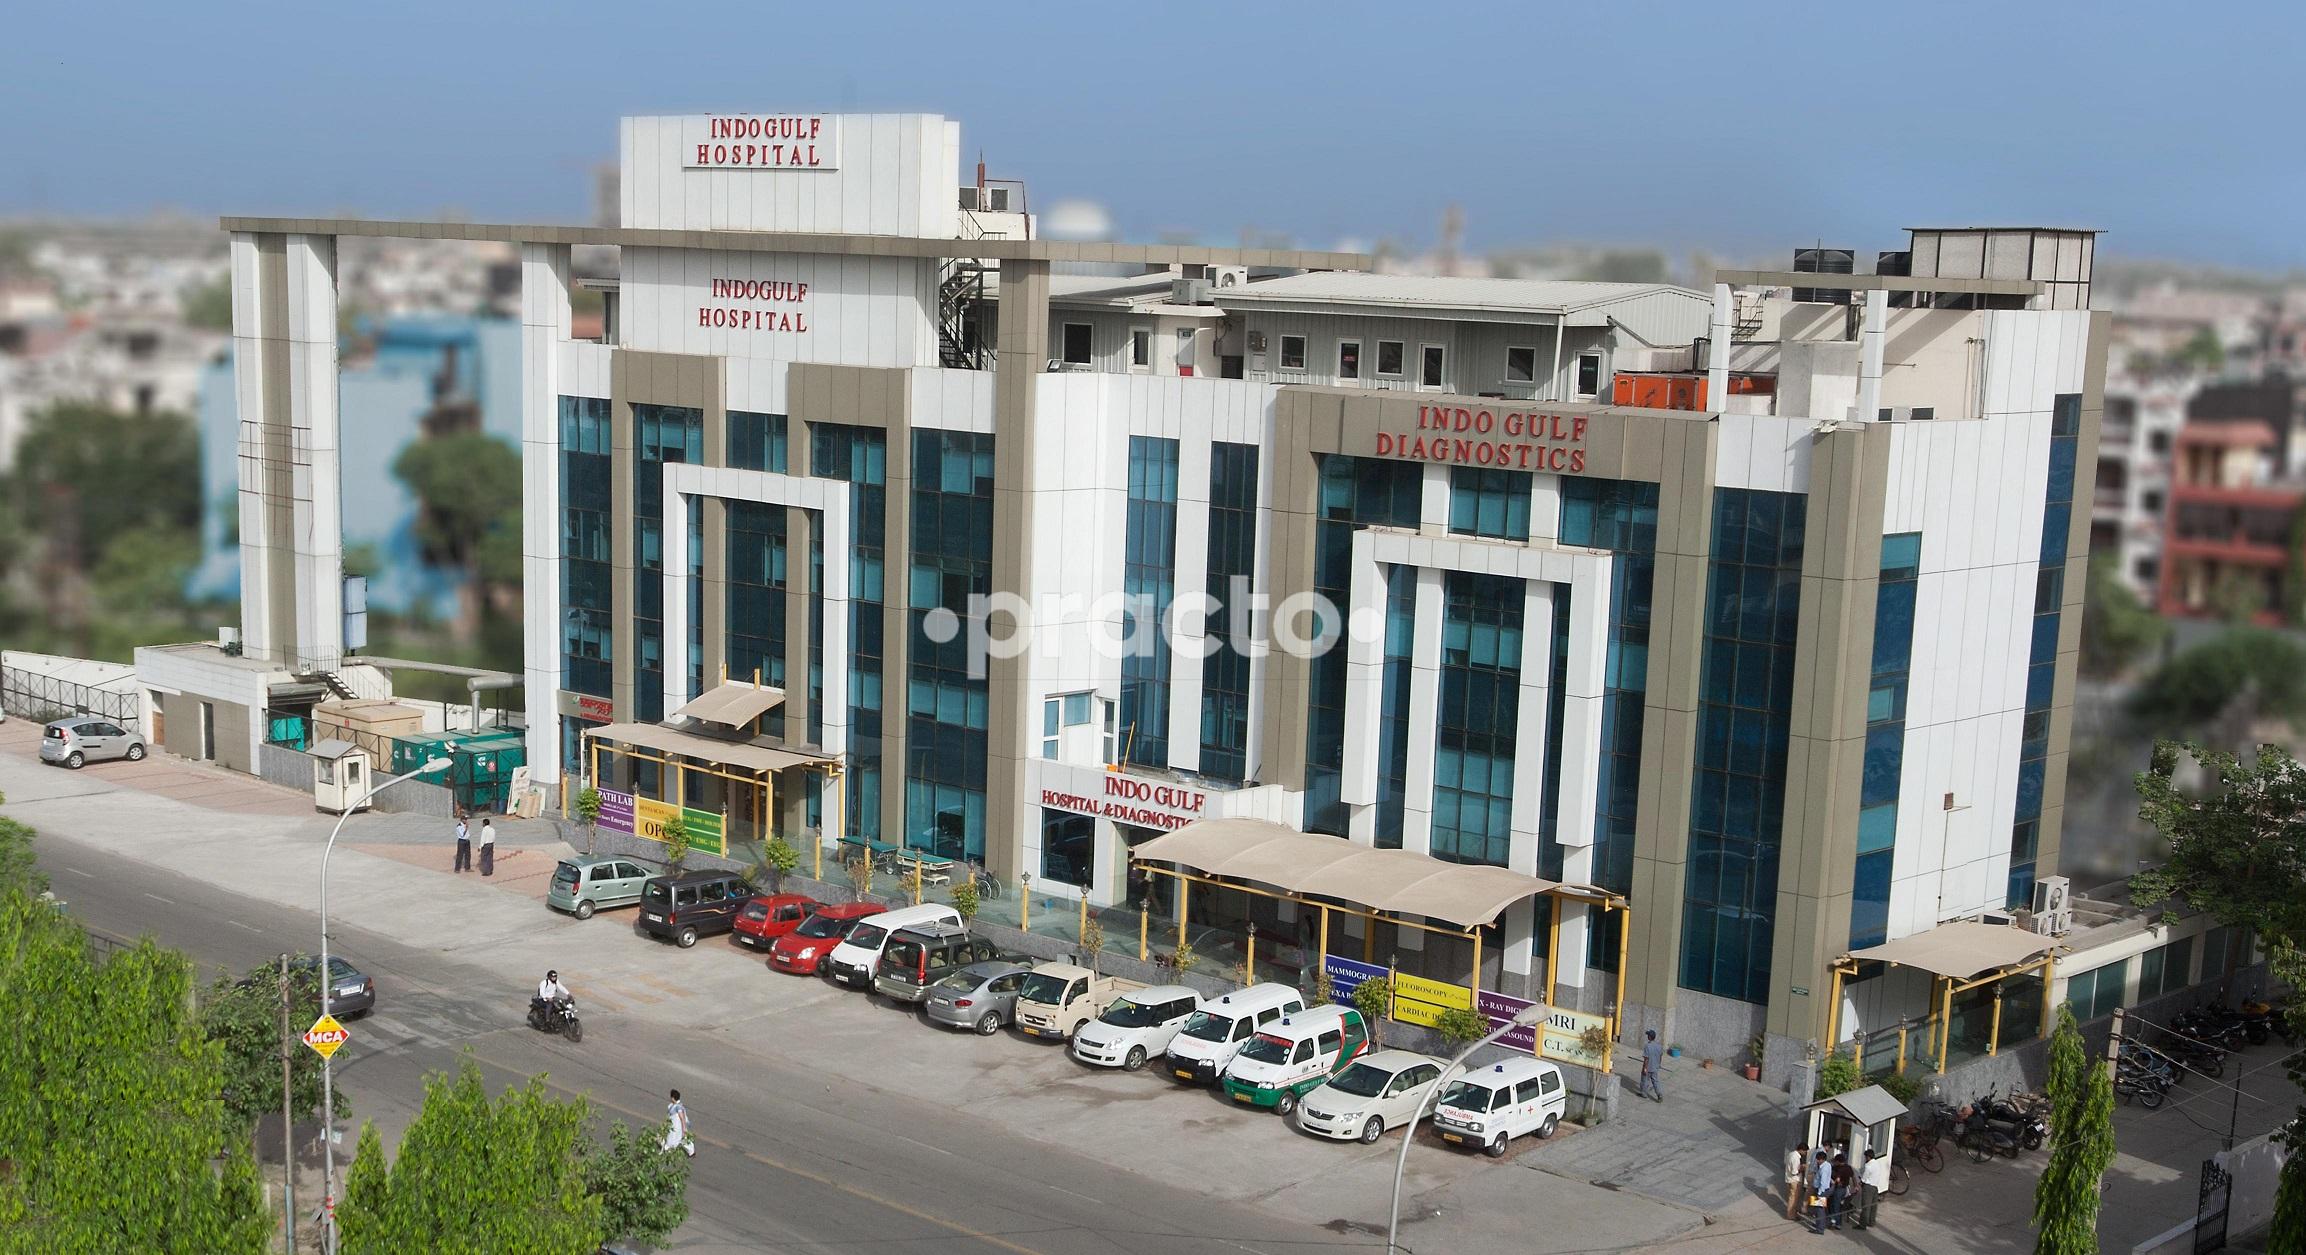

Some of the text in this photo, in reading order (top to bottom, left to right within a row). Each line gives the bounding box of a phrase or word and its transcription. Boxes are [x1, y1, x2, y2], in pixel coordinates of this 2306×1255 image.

[711, 117, 821, 139] INDOGULF
[697, 144, 821, 166] HOSPITAL
[712, 278, 808, 303] INDOGULF
[699, 307, 808, 333] HOSPITAL
[1418, 405, 1588, 441] INDO GULF
[1377, 432, 1585, 473] DIAGNOSTICS
[598, 791, 634, 807] PATH LAB
[1105, 776, 1205, 812] INDO GULF
[1042, 790, 1102, 815] HOSPITAL
[1114, 804, 1195, 831] DIAGNOSTI
[1328, 965, 1372, 982] MAMMOGRA
[1331, 990, 1346, 999] EXA
[1396, 1004, 1429, 1018] CARDIAC
[1546, 1014, 1575, 1031] MRI
[309, 1031, 344, 1044] MCA
[1491, 1026, 1534, 1043] ULASOUND
